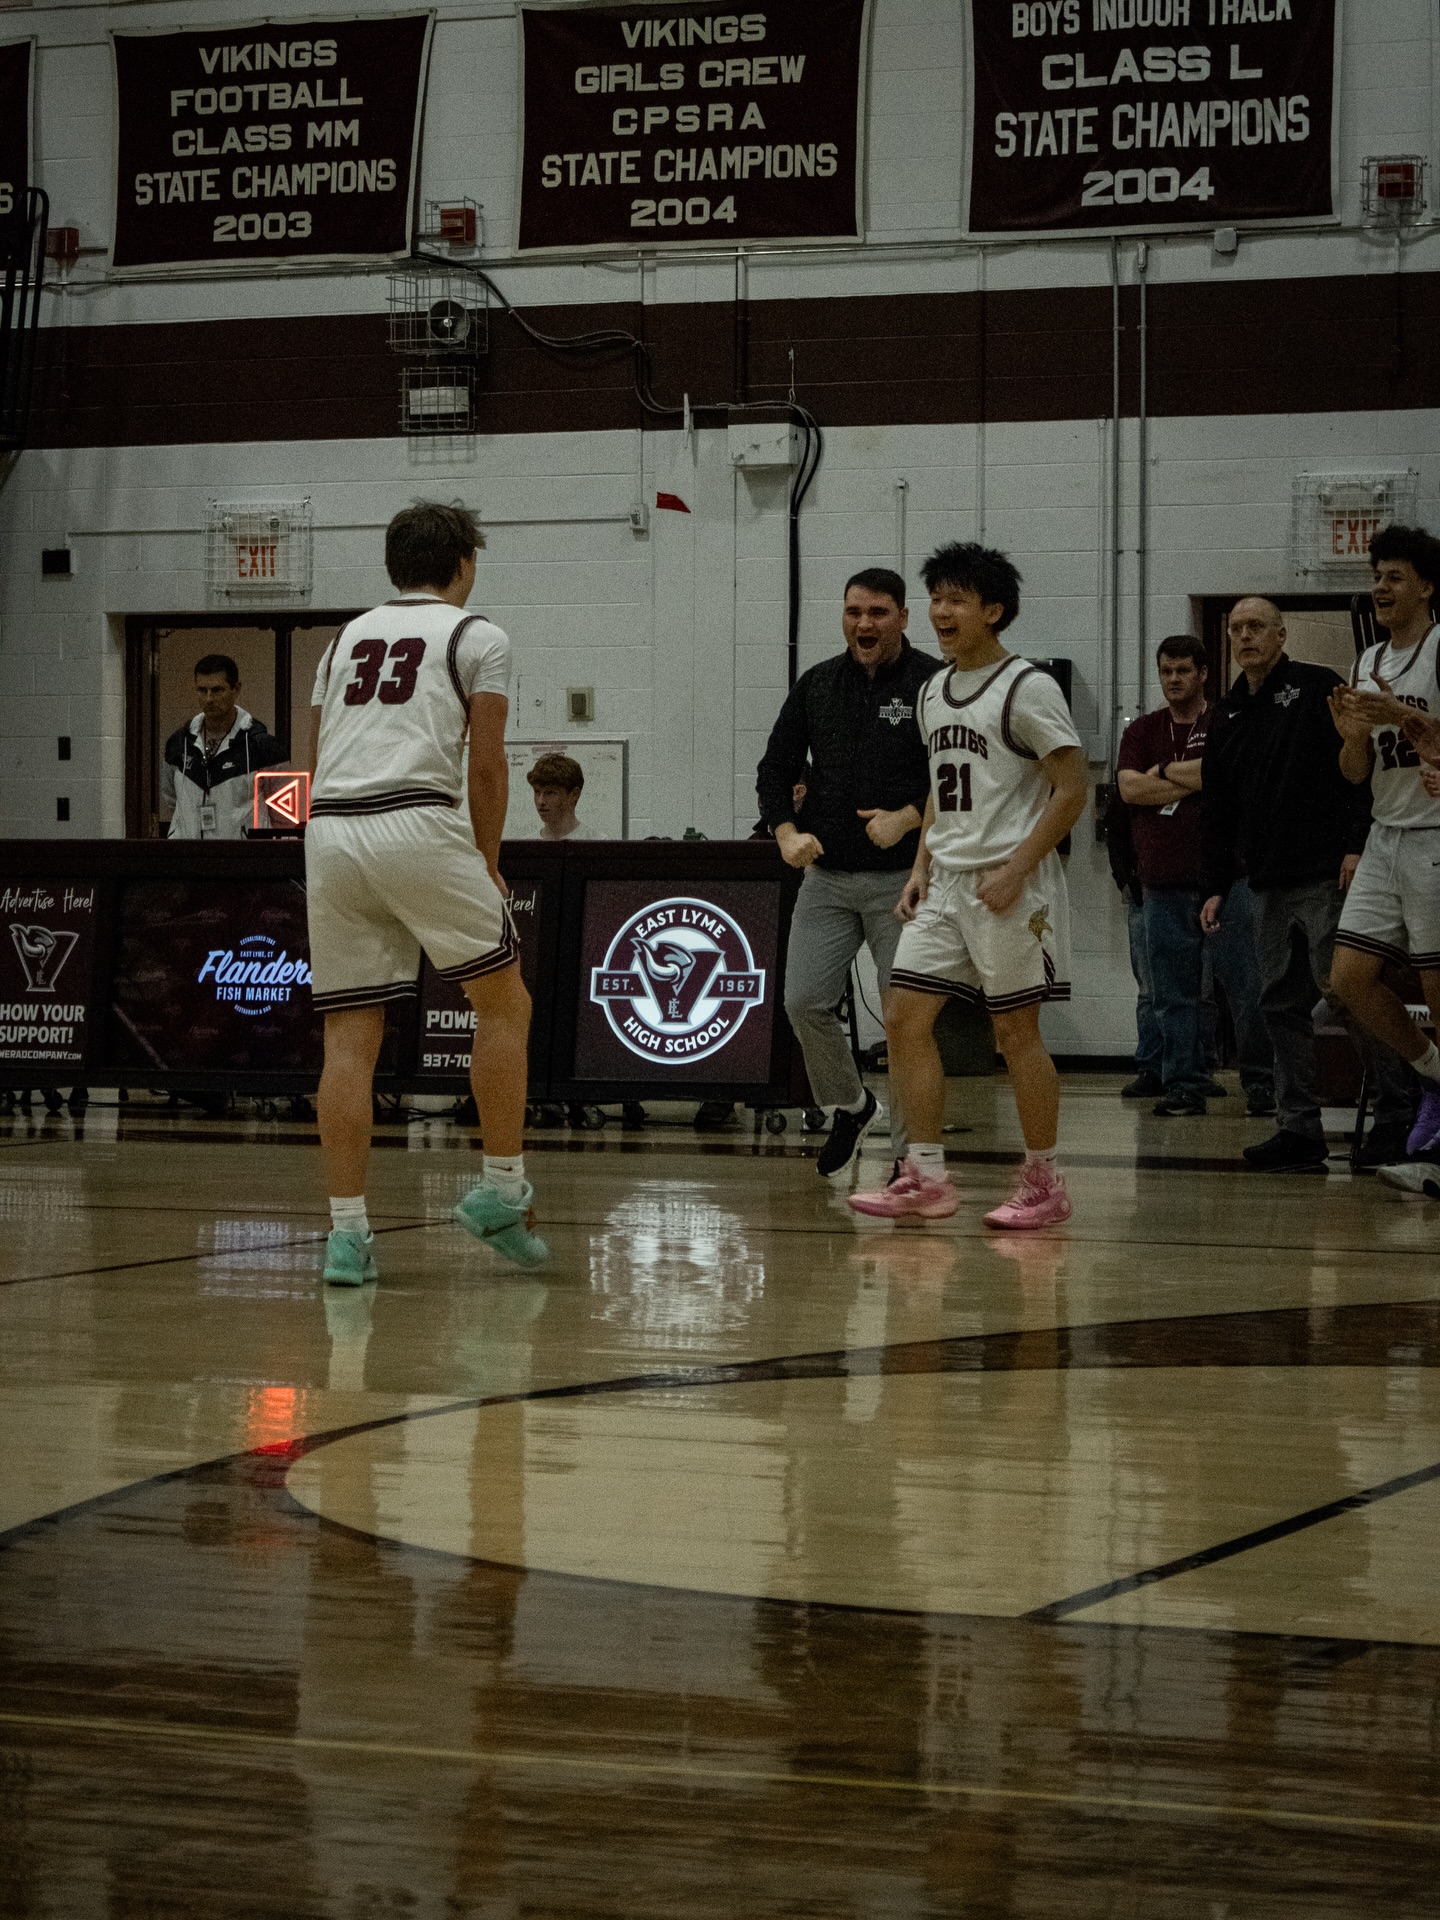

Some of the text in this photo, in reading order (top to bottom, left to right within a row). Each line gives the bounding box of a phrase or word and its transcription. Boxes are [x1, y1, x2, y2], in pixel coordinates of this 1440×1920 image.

[621, 13, 767, 49] VIKINGS
[1012, 0, 1080, 38] BOYS
[1092, 0, 1190, 32] INDOOR
[199, 39, 337, 74] VIKINGS
[575, 55, 806, 94] GIRLS CREW
[1041, 44, 1263, 91] CLASS L
[170, 78, 364, 117] FOOTBALL
[172, 120, 359, 157] CLASS MM
[995, 95, 1310, 158] STATE CHAMPIONS
[135, 158, 397, 205] STATE CHAMPIONS
[542, 142, 838, 188] STATE CHAMPIONS
[1081, 167, 1215, 207] 2004
[213, 211, 312, 243] 2003
[630, 195, 737, 228] 2004
[237, 545, 277, 577] EXIT
[344, 637, 427, 706] 33
[1377, 727, 1421, 771] 22
[937, 763, 972, 812] 21
[0, 887, 94, 914] Advertise Here!
[634, 908, 727, 939] EAST LYME
[240, 950, 252, 958] EAST
[216, 986, 292, 1002] FISH MARKET
[602, 978, 635, 991] EST.
[718, 979, 756, 992] 1967
[41, 1004, 85, 1023] YOUR
[0, 1024, 75, 1044] SUPPORT!
[622, 1015, 730, 1053] HIGH SCHOOL
